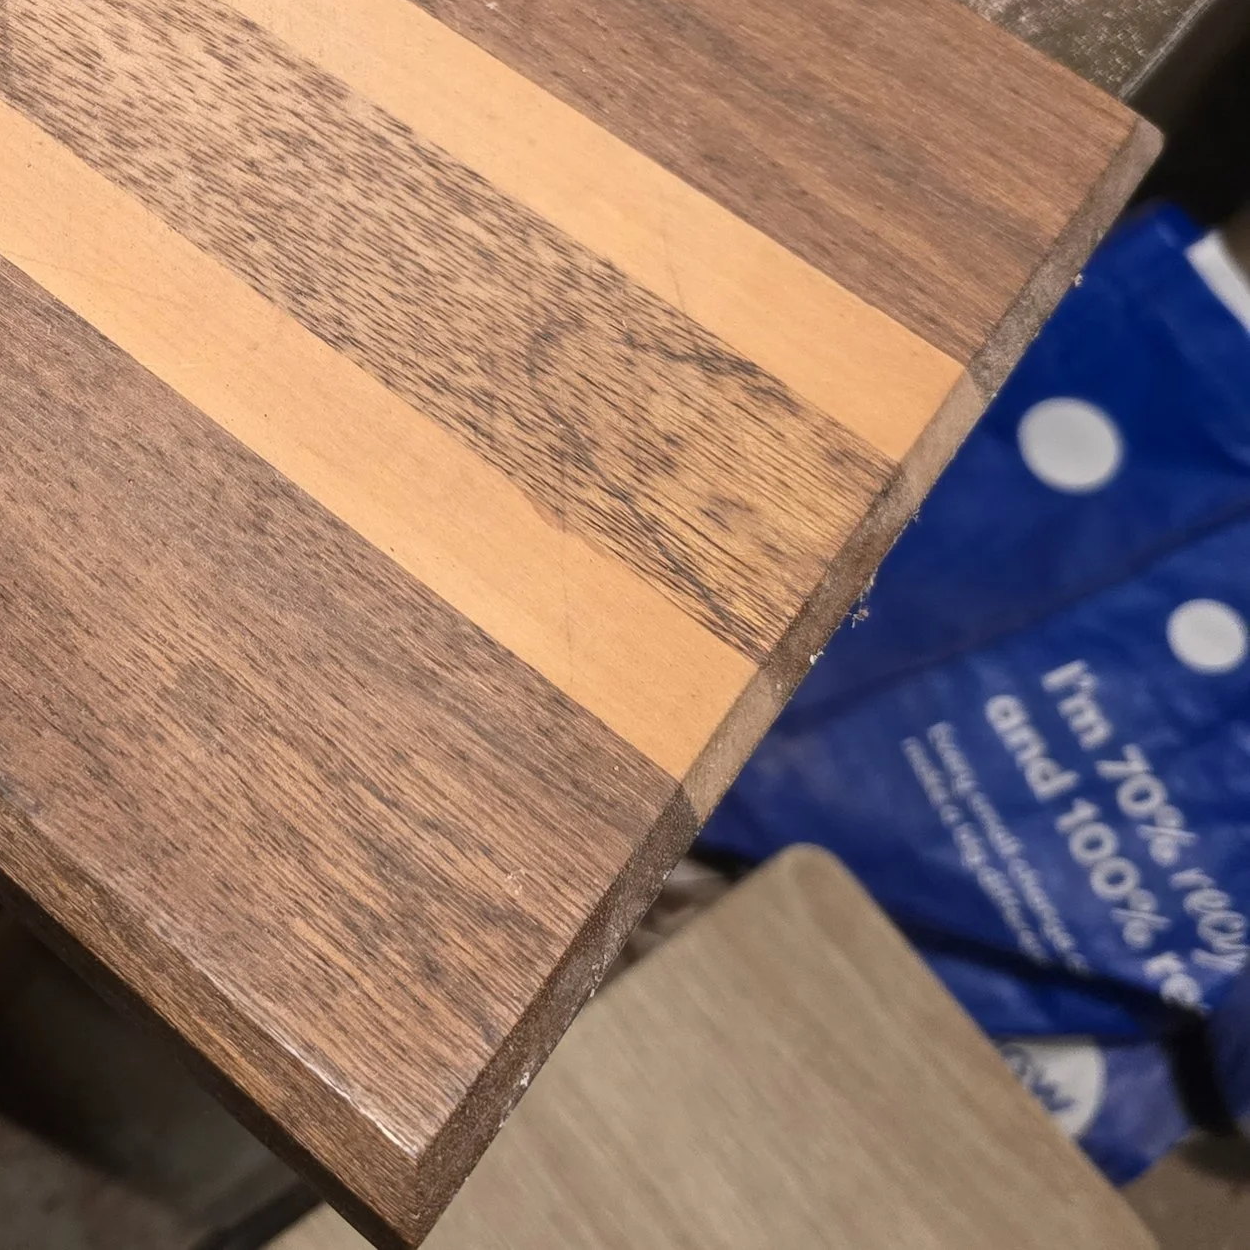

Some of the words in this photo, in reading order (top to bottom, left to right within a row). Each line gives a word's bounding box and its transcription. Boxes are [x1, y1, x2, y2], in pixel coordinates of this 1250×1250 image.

[985, 695, 1080, 801] and
[1055, 799, 1171, 948] 100%
[1042, 660, 1113, 749] I'm
[1095, 744, 1196, 867] 70%
